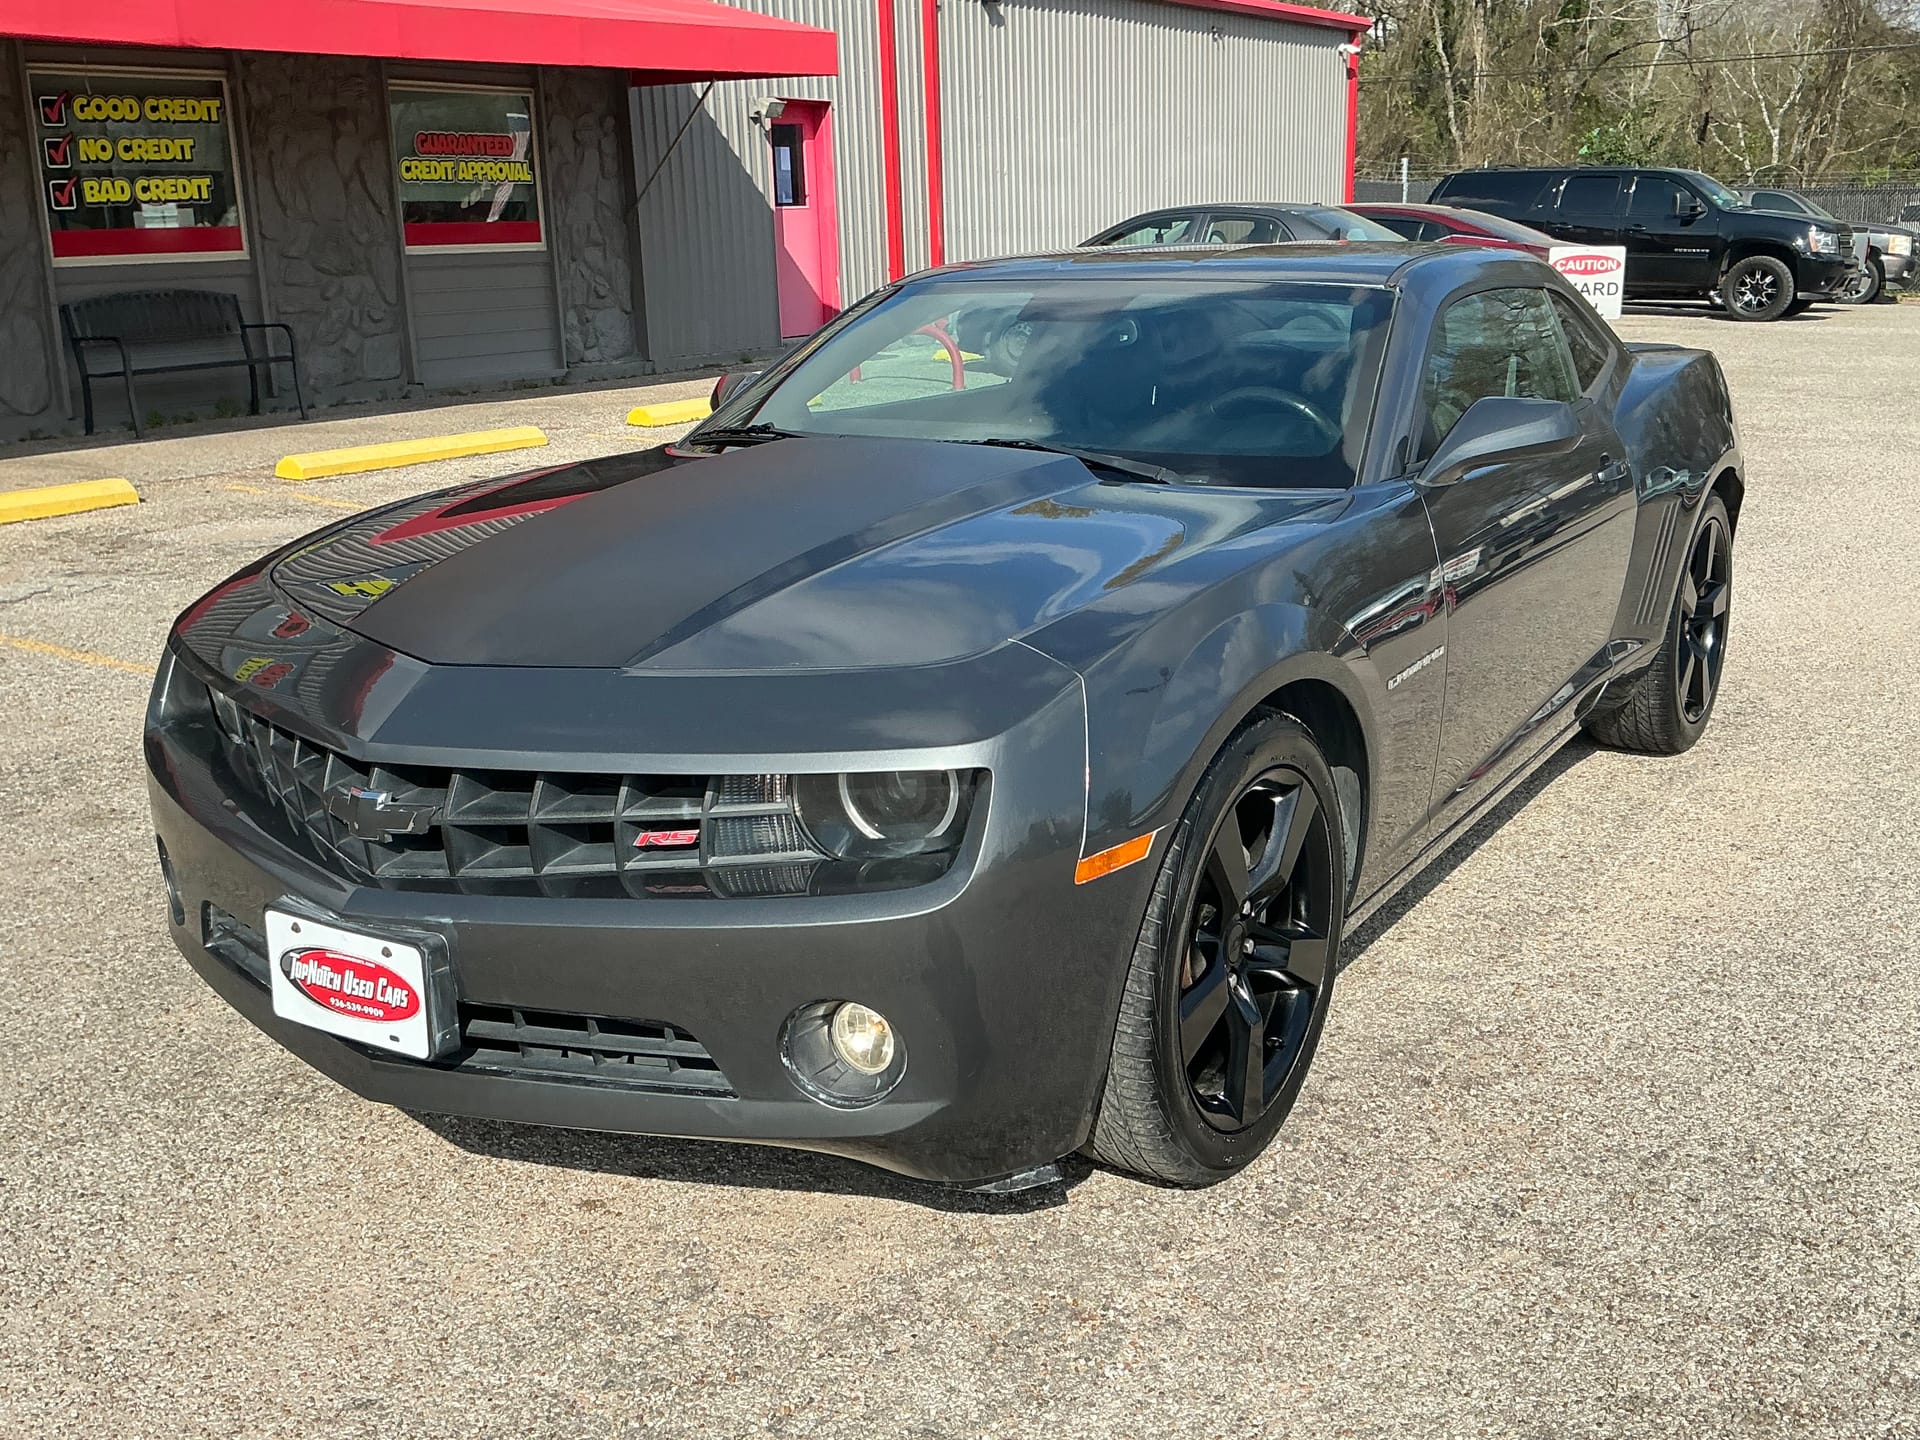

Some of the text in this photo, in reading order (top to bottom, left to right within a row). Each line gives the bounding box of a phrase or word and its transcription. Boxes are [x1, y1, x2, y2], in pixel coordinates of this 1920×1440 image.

[73, 97, 221, 122] GOOD CREDIT
[79, 138, 194, 161] NO CREDIT
[416, 132, 514, 157] GUARANTEED
[401, 160, 532, 182] CREDIT APPROVAL
[83, 178, 211, 203] BAD CREDIT
[1555, 259, 1617, 271] CAUTION
[1574, 282, 1619, 296] ARD
[633, 829, 700, 847] RS
[330, 997, 384, 1018] 936-539-9909
